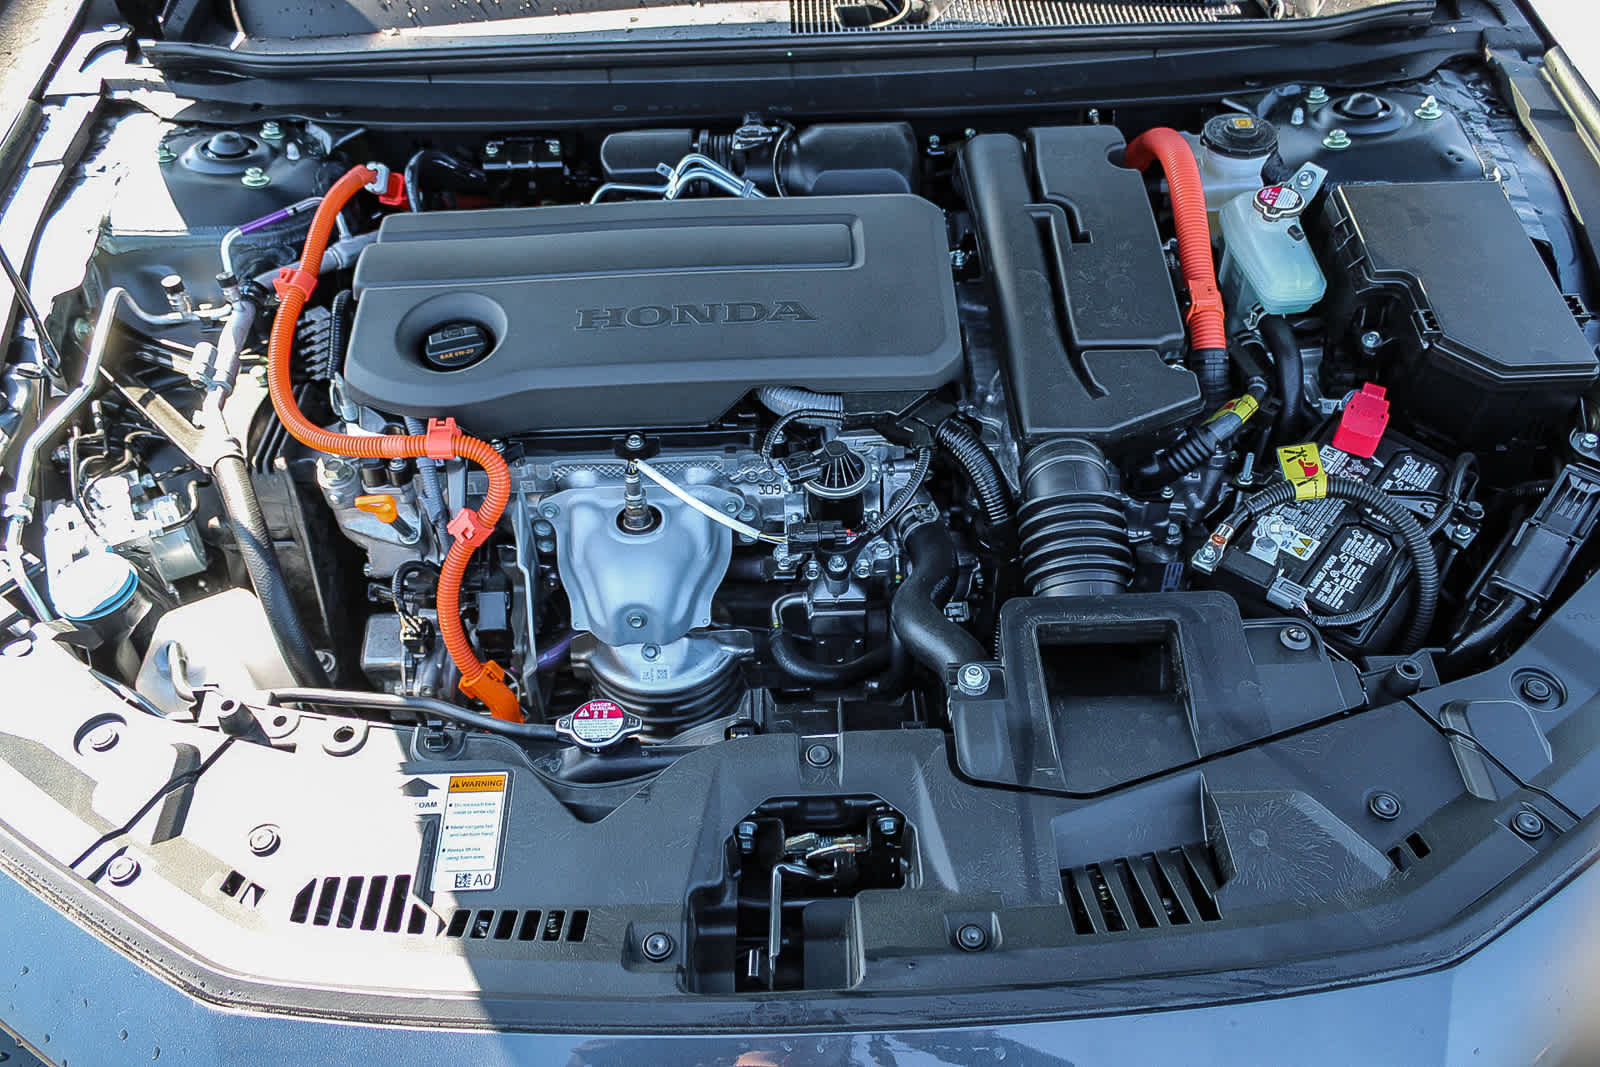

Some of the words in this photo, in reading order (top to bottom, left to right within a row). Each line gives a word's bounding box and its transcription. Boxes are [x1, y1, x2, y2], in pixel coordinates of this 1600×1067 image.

[574, 299, 817, 331] HONDA
[758, 484, 782, 495] 309
[461, 780, 503, 788] WARNING
